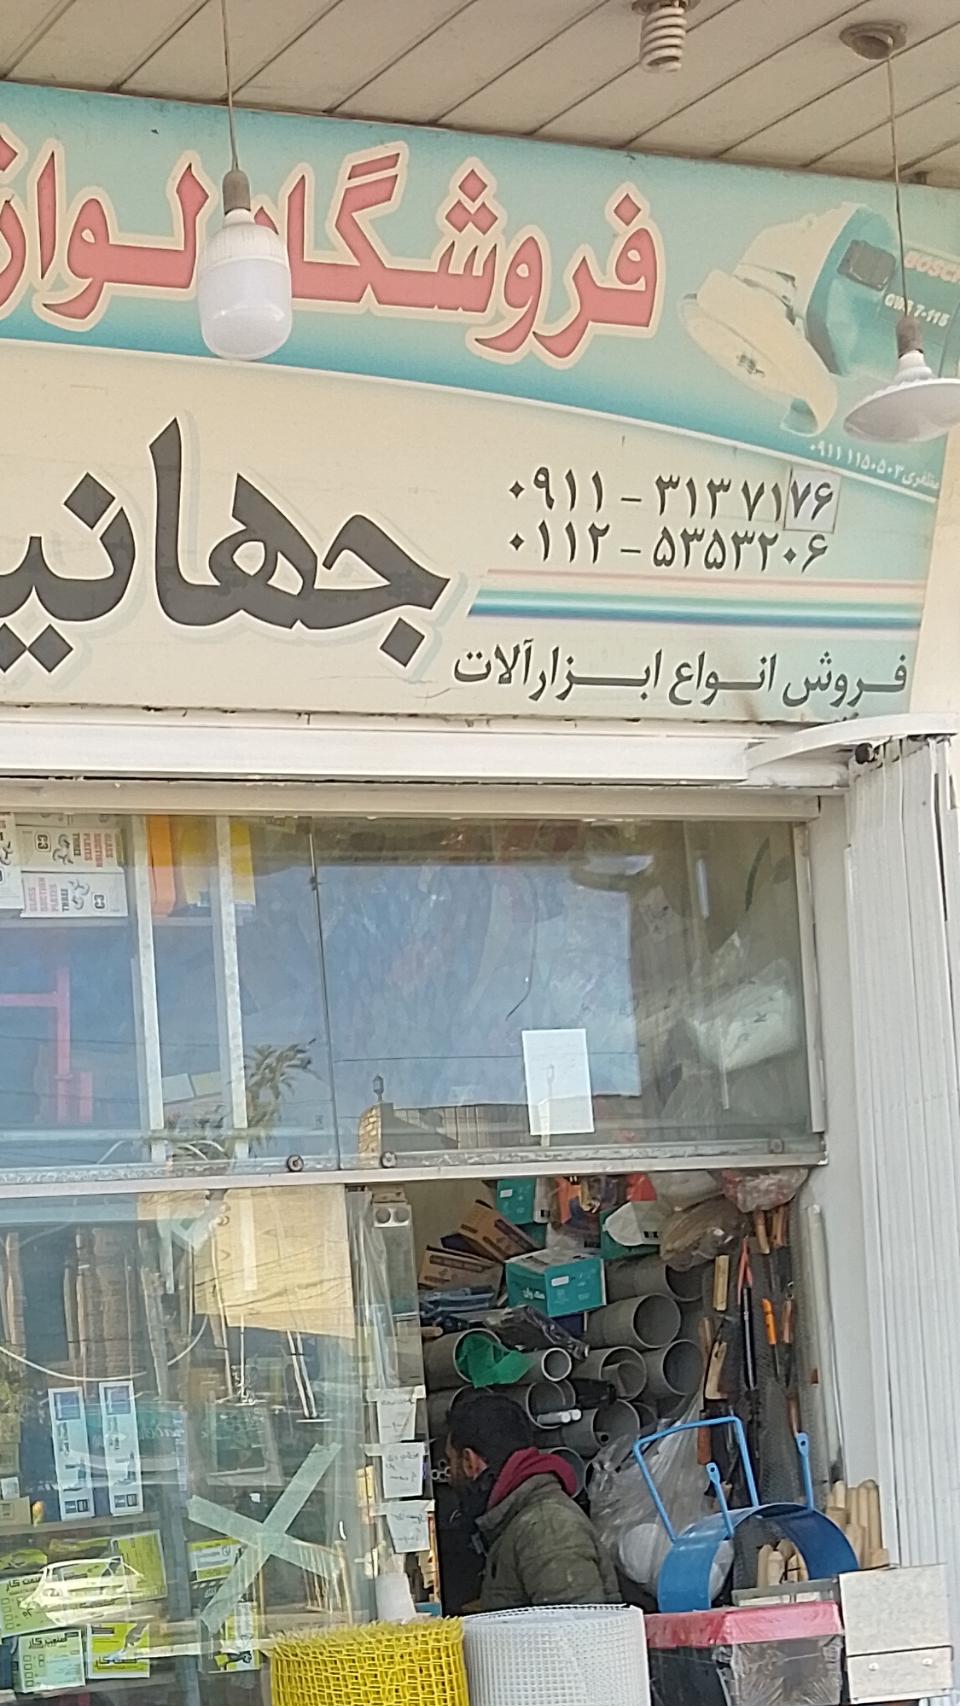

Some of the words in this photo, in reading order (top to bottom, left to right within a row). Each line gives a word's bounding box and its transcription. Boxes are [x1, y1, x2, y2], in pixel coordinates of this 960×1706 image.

[253, 150, 658, 360] فروشگا
[668, 650, 778, 706] انواع
[782, 650, 908, 708] فروش
[37, 834, 49, 850] C3
[94, 894, 106, 909] C3
